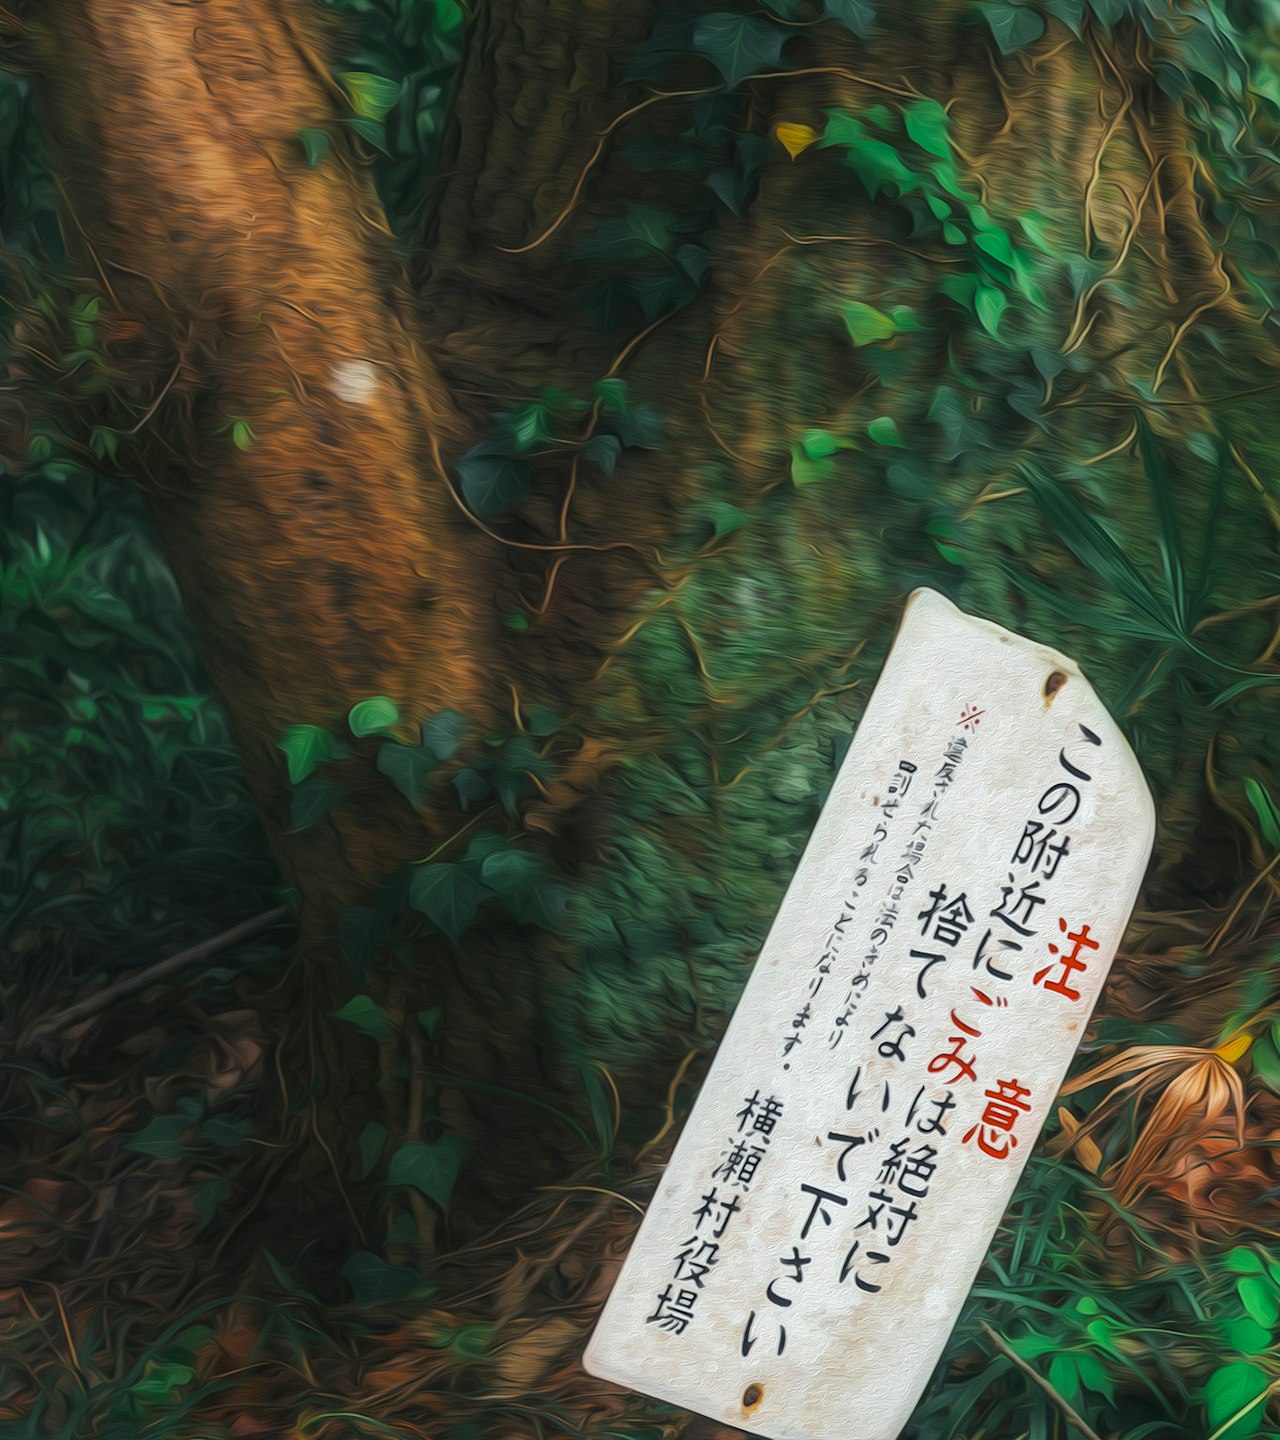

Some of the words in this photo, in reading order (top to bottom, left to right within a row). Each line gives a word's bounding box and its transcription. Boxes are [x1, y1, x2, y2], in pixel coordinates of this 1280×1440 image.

[741, 882, 976, 1358] 捨てないで下さい
[838, 723, 1102, 1294] この附近にごみは絶対に
[962, 917, 1100, 1160] 注意
[646, 1088, 784, 1337] 横瀬村役場
